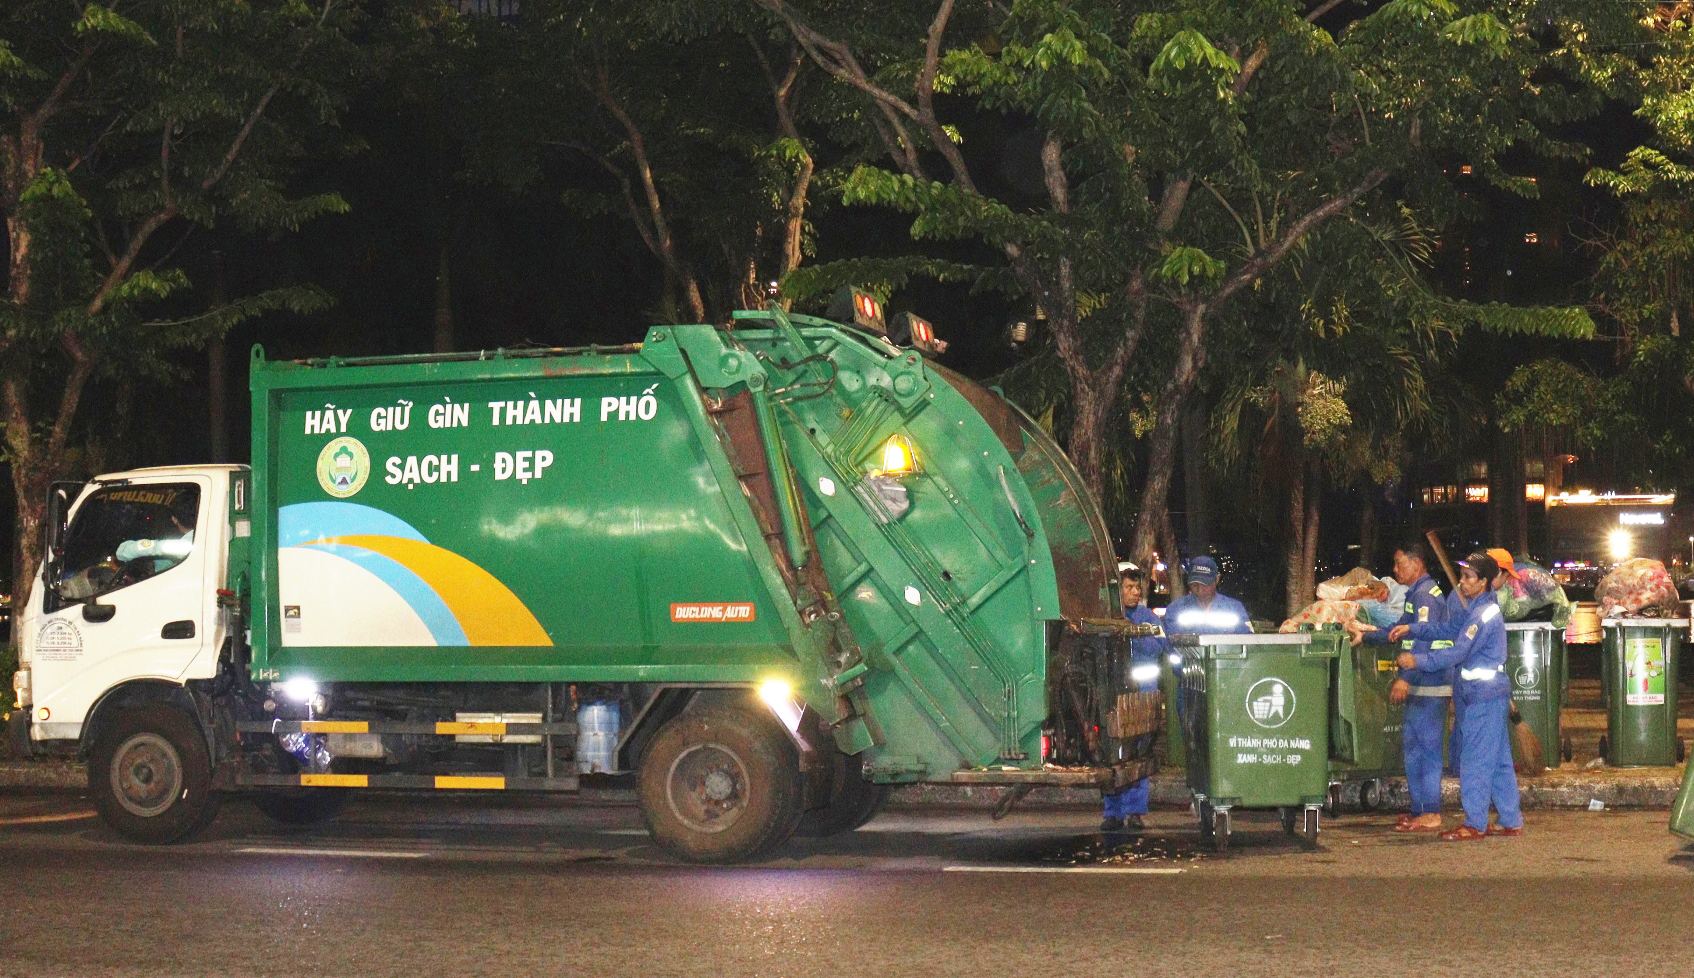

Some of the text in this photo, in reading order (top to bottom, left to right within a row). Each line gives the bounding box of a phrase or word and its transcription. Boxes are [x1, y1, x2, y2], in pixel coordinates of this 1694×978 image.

[304, 383, 659, 435] HÃY GIỮ GÌN THÀNH PHỐ
[385, 453, 459, 490] SẠCH
[493, 449, 554, 485] ĐẸP
[675, 605, 750, 621] DUCLONG AUTO
[1238, 736, 1262, 748] THÀNH
[1237, 753, 1257, 764] XANH
